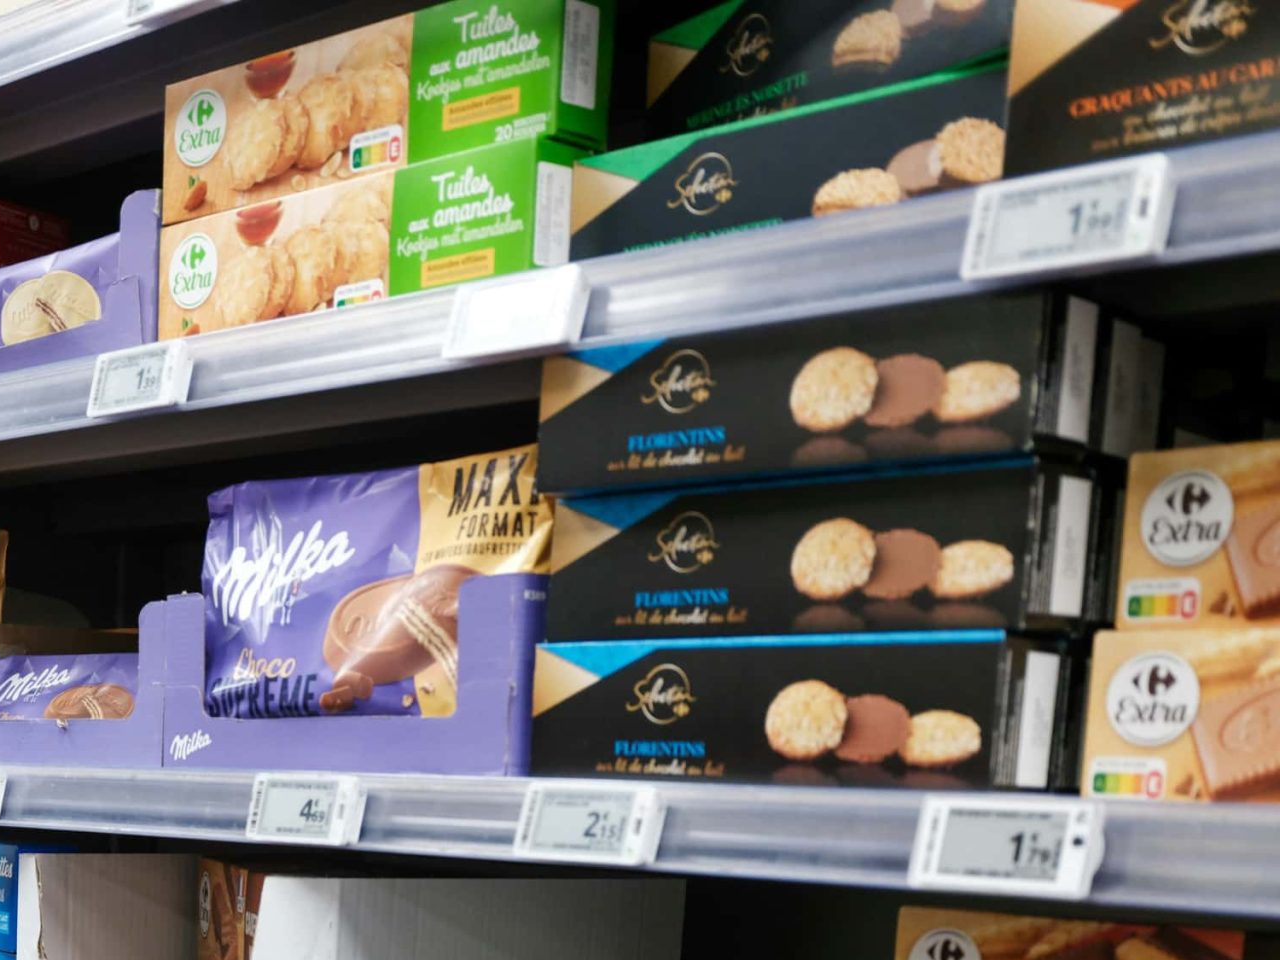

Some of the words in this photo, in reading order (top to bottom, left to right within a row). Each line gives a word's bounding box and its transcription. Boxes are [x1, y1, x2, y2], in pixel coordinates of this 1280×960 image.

[454, 5, 515, 43] Tuiles
[430, 61, 450, 76] aux
[456, 25, 540, 69] amandes
[179, 127, 220, 153] Extra
[495, 125, 512, 143] 20
[431, 165, 490, 202] Tuiles
[409, 218, 429, 233] aux
[434, 187, 514, 228] amandes
[173, 271, 212, 295] Extra
[628, 426, 725, 452] FLORENTINS
[456, 512, 538, 540] FORMAT
[1148, 514, 1223, 546] Extra
[211, 520, 356, 626] Milka
[635, 588, 729, 608] FLORENTINS
[233, 647, 296, 681] Choco
[1114, 696, 1190, 727] Extra
[169, 728, 212, 761] Milka
[614, 740, 706, 757] FLORENTINS
